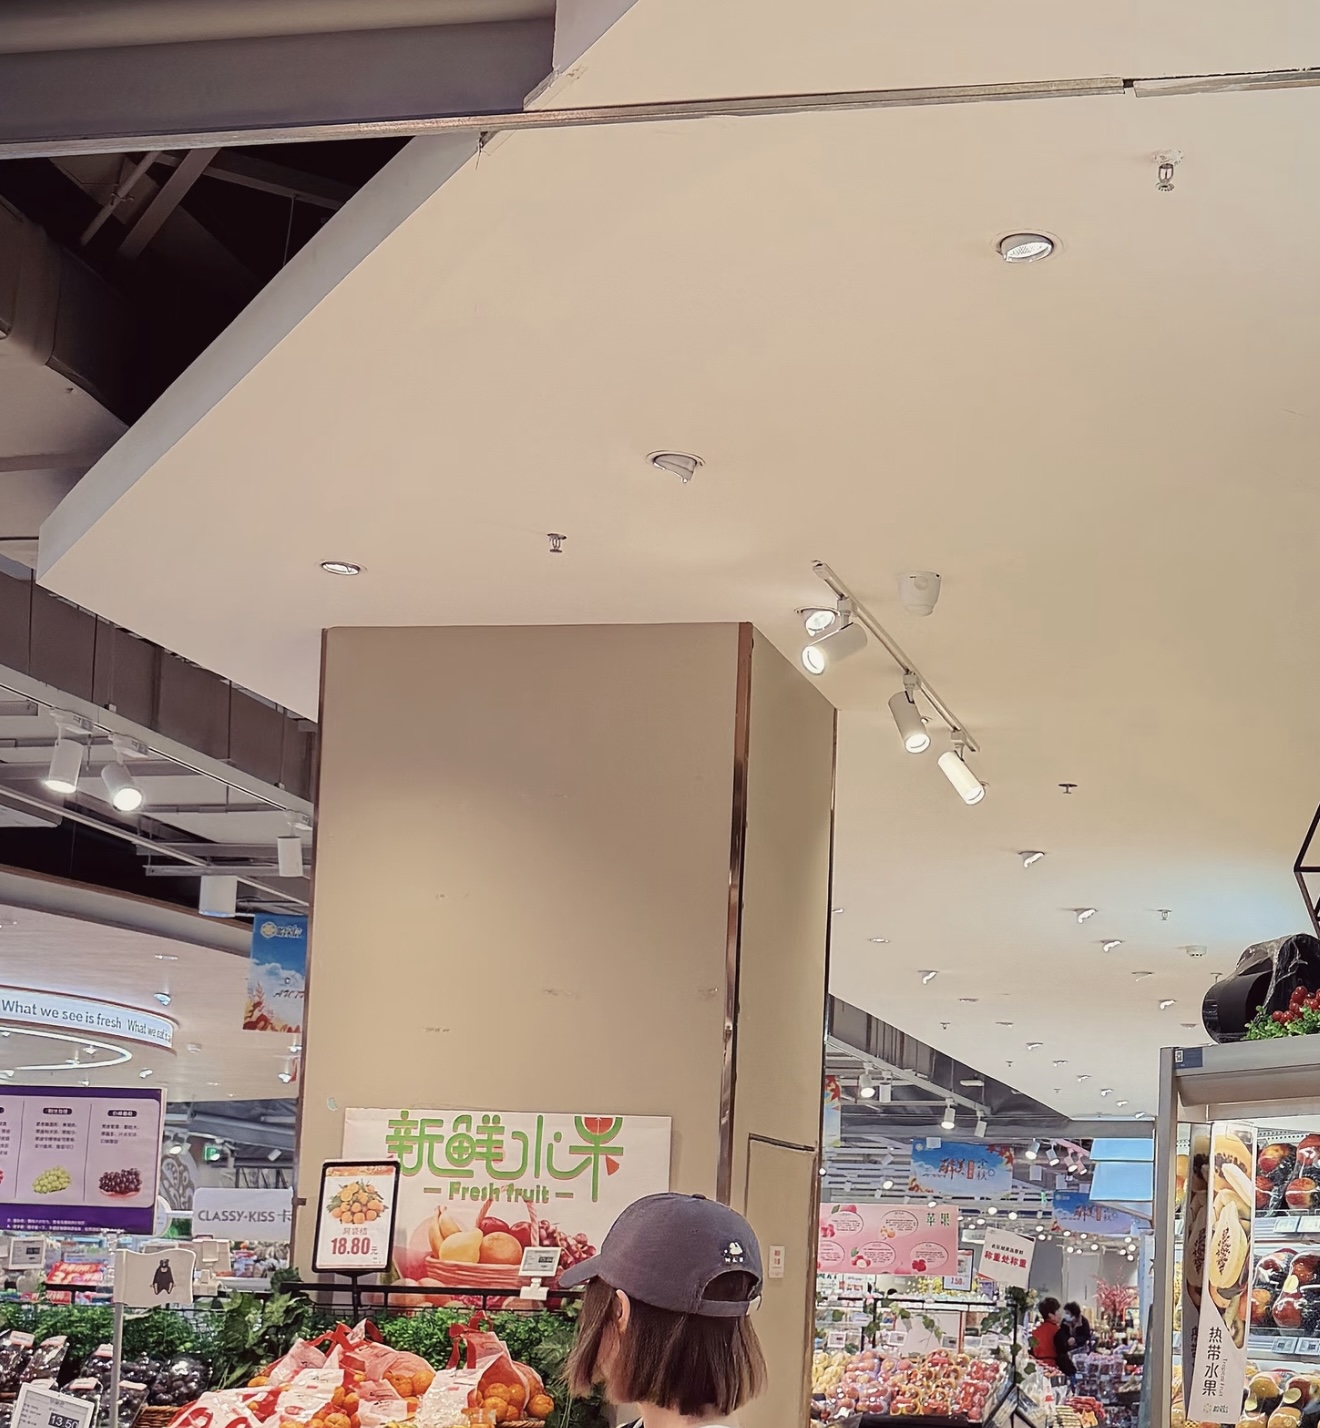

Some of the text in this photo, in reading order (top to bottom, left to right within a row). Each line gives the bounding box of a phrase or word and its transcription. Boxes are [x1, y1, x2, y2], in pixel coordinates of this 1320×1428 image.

[1, 999, 37, 1016] What
[40, 1007, 59, 1018] we
[62, 1010, 83, 1023] see
[85, 1011, 94, 1024] is
[96, 1013, 122, 1029] fresh
[127, 1018, 147, 1034] What
[147, 1026, 157, 1036] we
[385, 1109, 624, 1203] 新鲜水果
[448, 1181, 550, 1204] Fresh fruit
[926, 1212, 950, 1227] 苹果
[331, 1236, 371, 1256] 18.80
[984, 1250, 1027, 1268] 称重处称重
[1201, 1326, 1222, 1396] 热带水果
